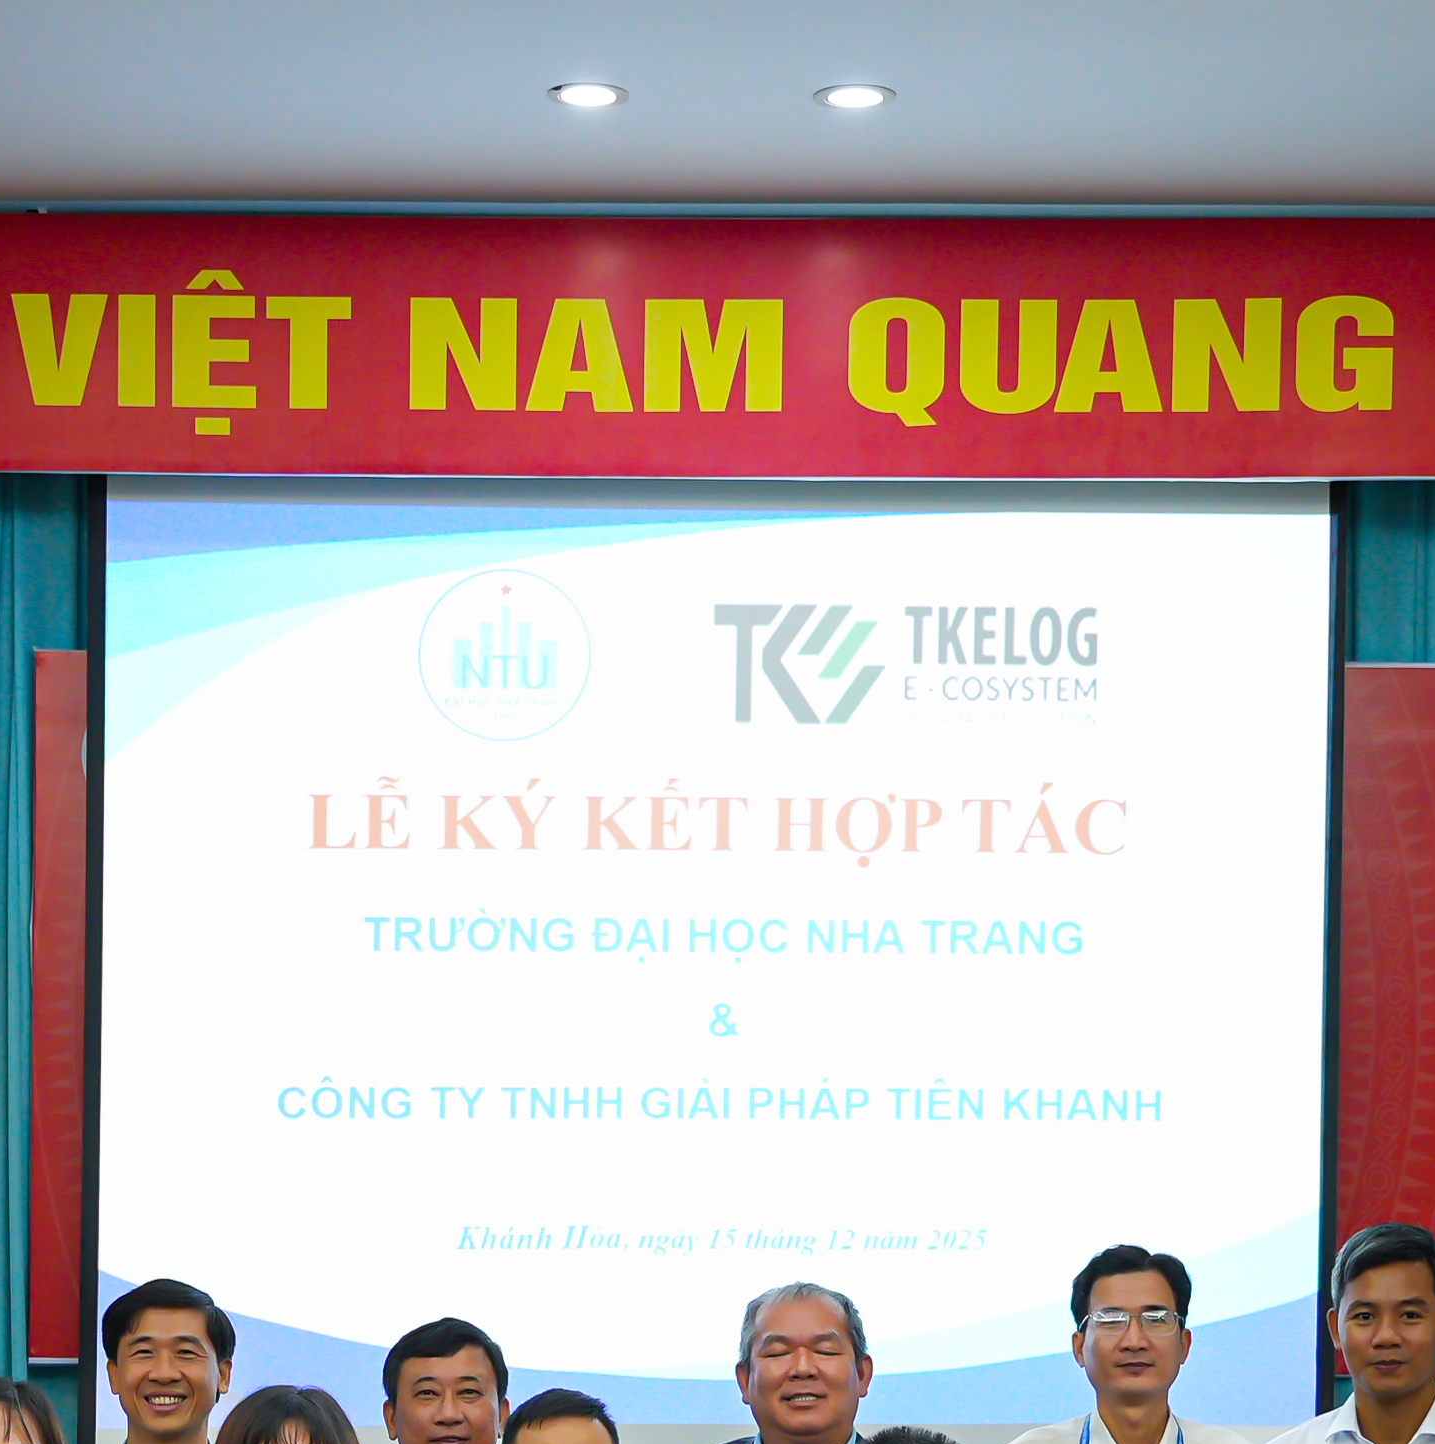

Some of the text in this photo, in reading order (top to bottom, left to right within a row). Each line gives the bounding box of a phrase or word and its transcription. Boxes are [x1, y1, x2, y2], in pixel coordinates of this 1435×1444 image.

[11, 269, 353, 436] VIỆT
[409, 297, 784, 412] NAM
[847, 295, 1395, 427] QUANG
[904, 606, 1098, 667] TKELOG
[461, 654, 549, 689] NTU
[308, 775, 1127, 869] LỄ KÝ KẾT HỢP TÁC
[364, 907, 1084, 965] TRƯỜNG ĐẠI HỌC NHA TRANG
[707, 1002, 739, 1038] &
[277, 1075, 413, 1121] CÔNG
[430, 1086, 486, 1120] TY
[501, 1086, 623, 1120] TNHH
[640, 1077, 731, 1120] GIẢI
[747, 1077, 871, 1121] PHÁP
[1003, 1088, 1163, 1123] KHANH
[456, 1224, 988, 1257] Khánh Hòa, ngày 15 tháng 12 năm 2025
